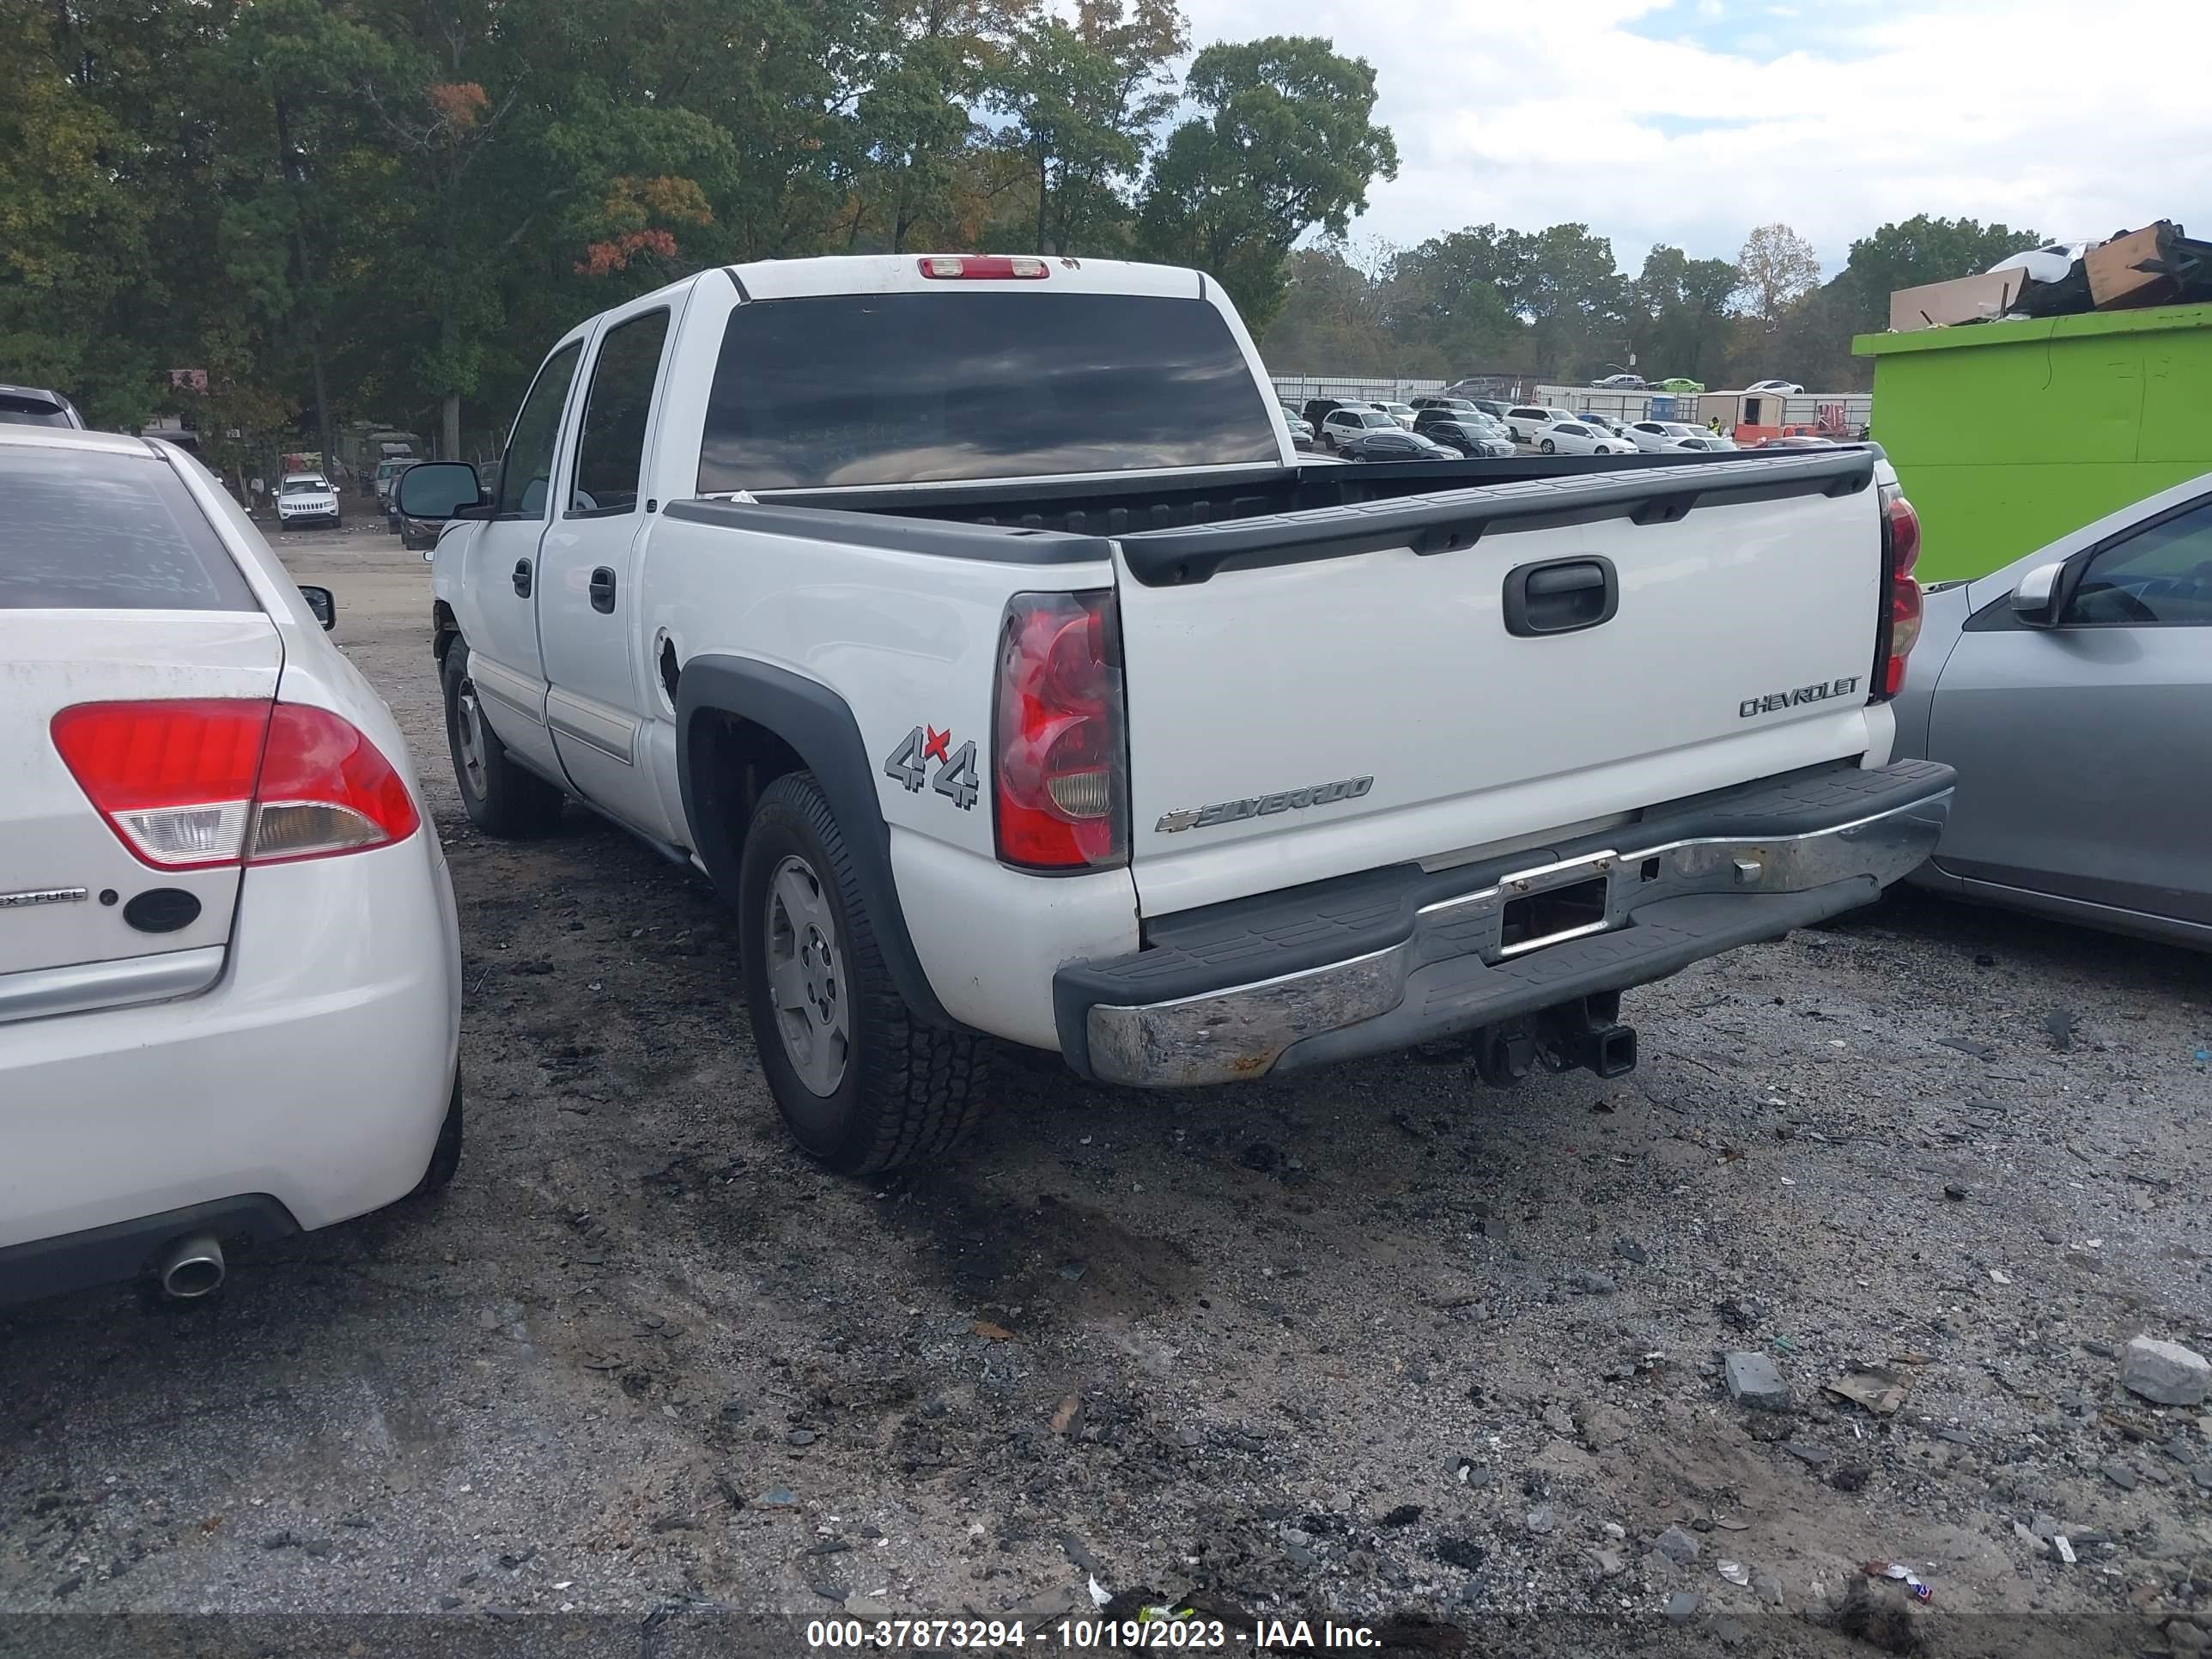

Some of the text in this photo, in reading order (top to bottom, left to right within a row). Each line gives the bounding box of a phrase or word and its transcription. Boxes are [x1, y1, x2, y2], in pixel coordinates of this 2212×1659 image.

[1739, 674, 1863, 718] CHEVROLET
[1194, 775, 1374, 828] SILVERADO
[35, 891, 83, 902] FUEL
